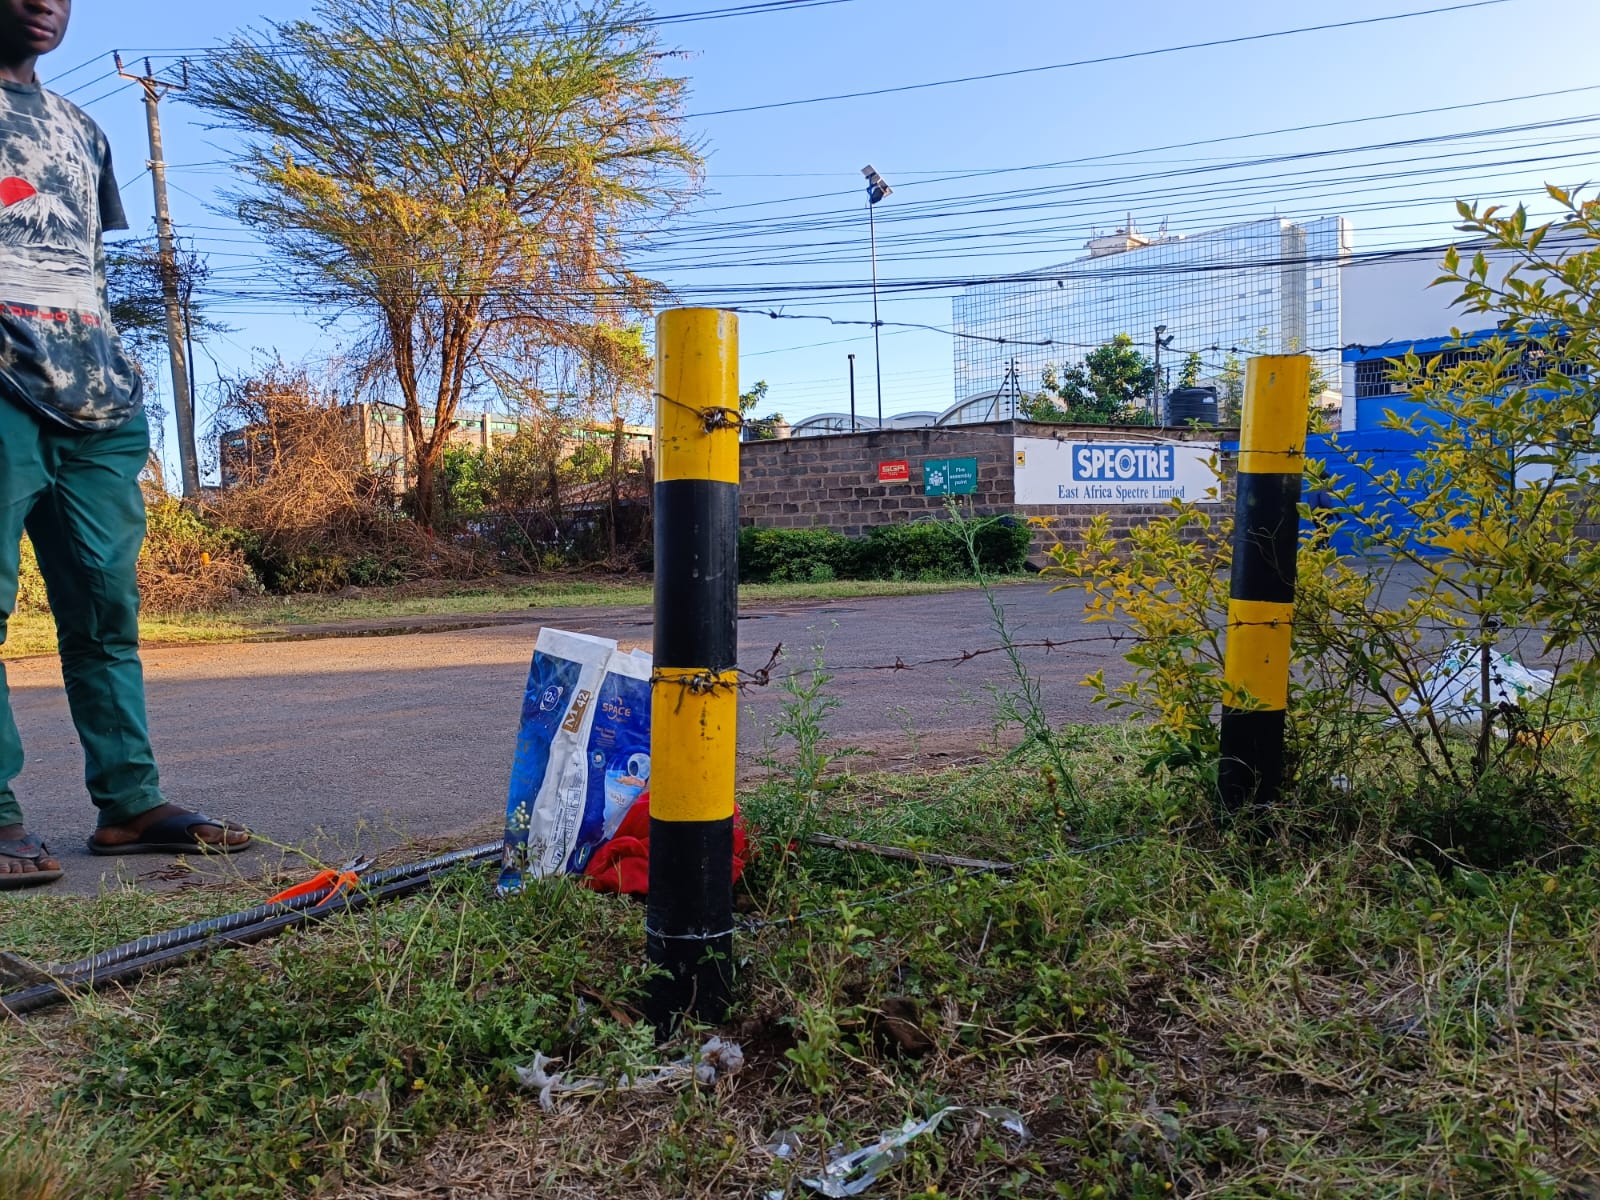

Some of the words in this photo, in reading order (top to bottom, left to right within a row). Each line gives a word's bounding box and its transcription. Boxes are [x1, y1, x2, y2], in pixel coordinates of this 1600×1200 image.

[1077, 448, 1169, 478] SPECTRE
[1058, 484, 1079, 499] East
[1083, 484, 1112, 499] Africa
[1115, 484, 1149, 501] Spectre
[1152, 484, 1185, 499] Limited
[576, 692, 588, 708] 42
[602, 702, 631, 718] SPACE
